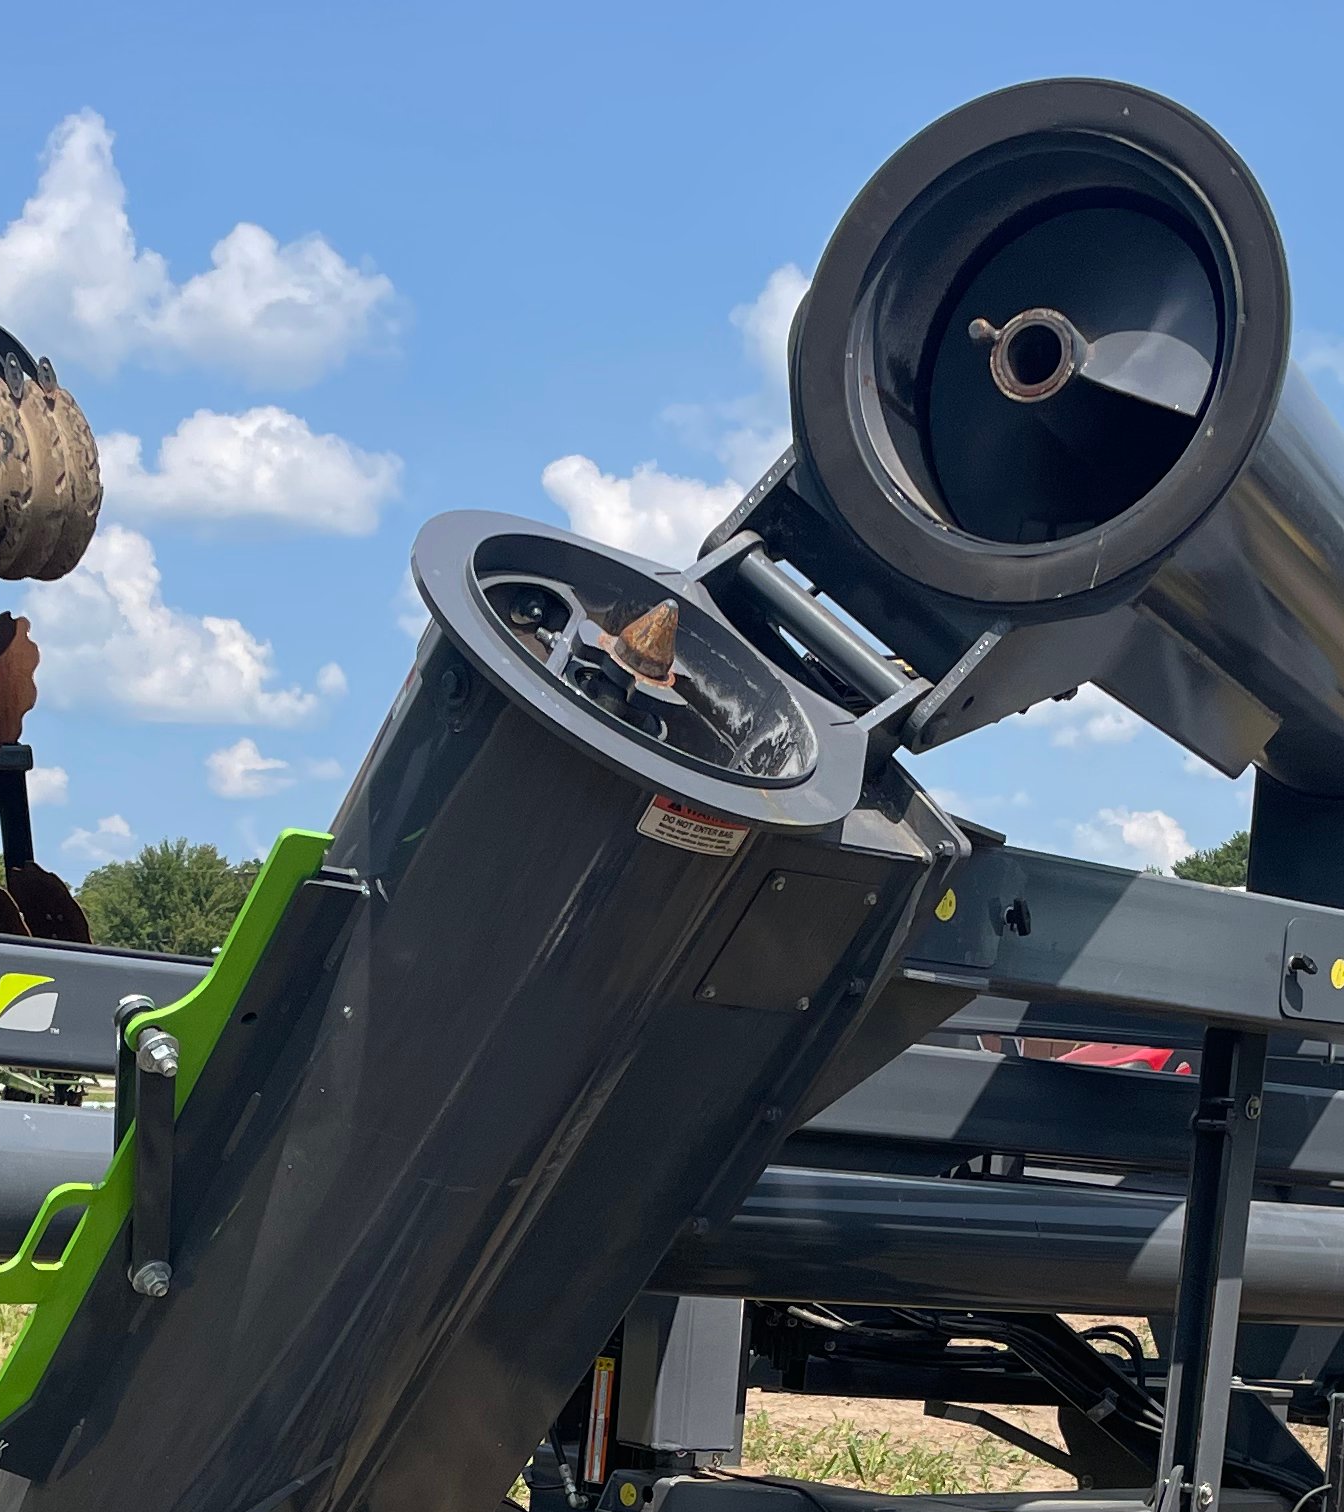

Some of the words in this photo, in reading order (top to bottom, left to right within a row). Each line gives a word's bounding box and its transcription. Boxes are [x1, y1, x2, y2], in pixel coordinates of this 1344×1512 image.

[662, 814, 674, 824] DO
[675, 819, 693, 829] NOT
[694, 824, 716, 836] ENTER
